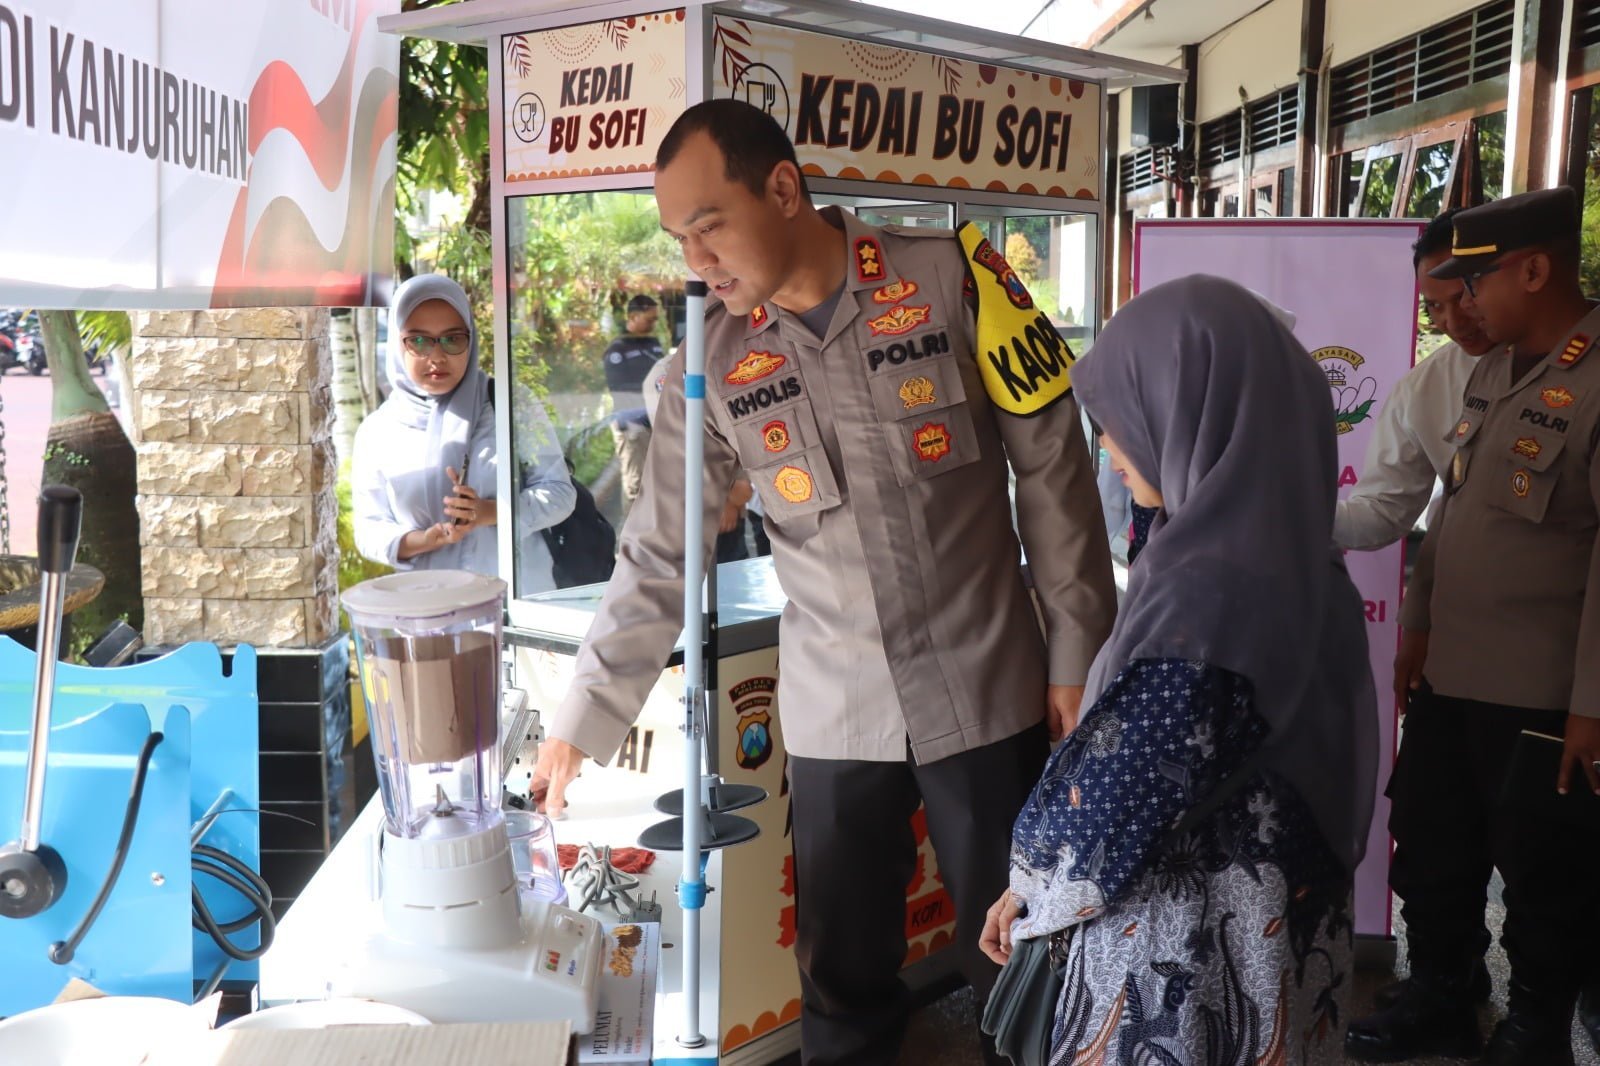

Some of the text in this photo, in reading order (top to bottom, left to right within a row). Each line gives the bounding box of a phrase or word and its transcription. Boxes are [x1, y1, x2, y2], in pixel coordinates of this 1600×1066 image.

[50, 25, 247, 182] KANJURUHAN
[560, 62, 633, 108] KEDAI
[548, 107, 647, 154] BU SOFI
[795, 72, 1072, 173] KEDAI BU SOFI
[867, 332, 949, 371] POLRI
[987, 310, 1076, 402] KAOP
[727, 376, 801, 419] KHOLIS
[1519, 407, 1568, 433] POLRI
[911, 899, 943, 928] KOPI
[592, 1011, 613, 1055] PELUMAT
